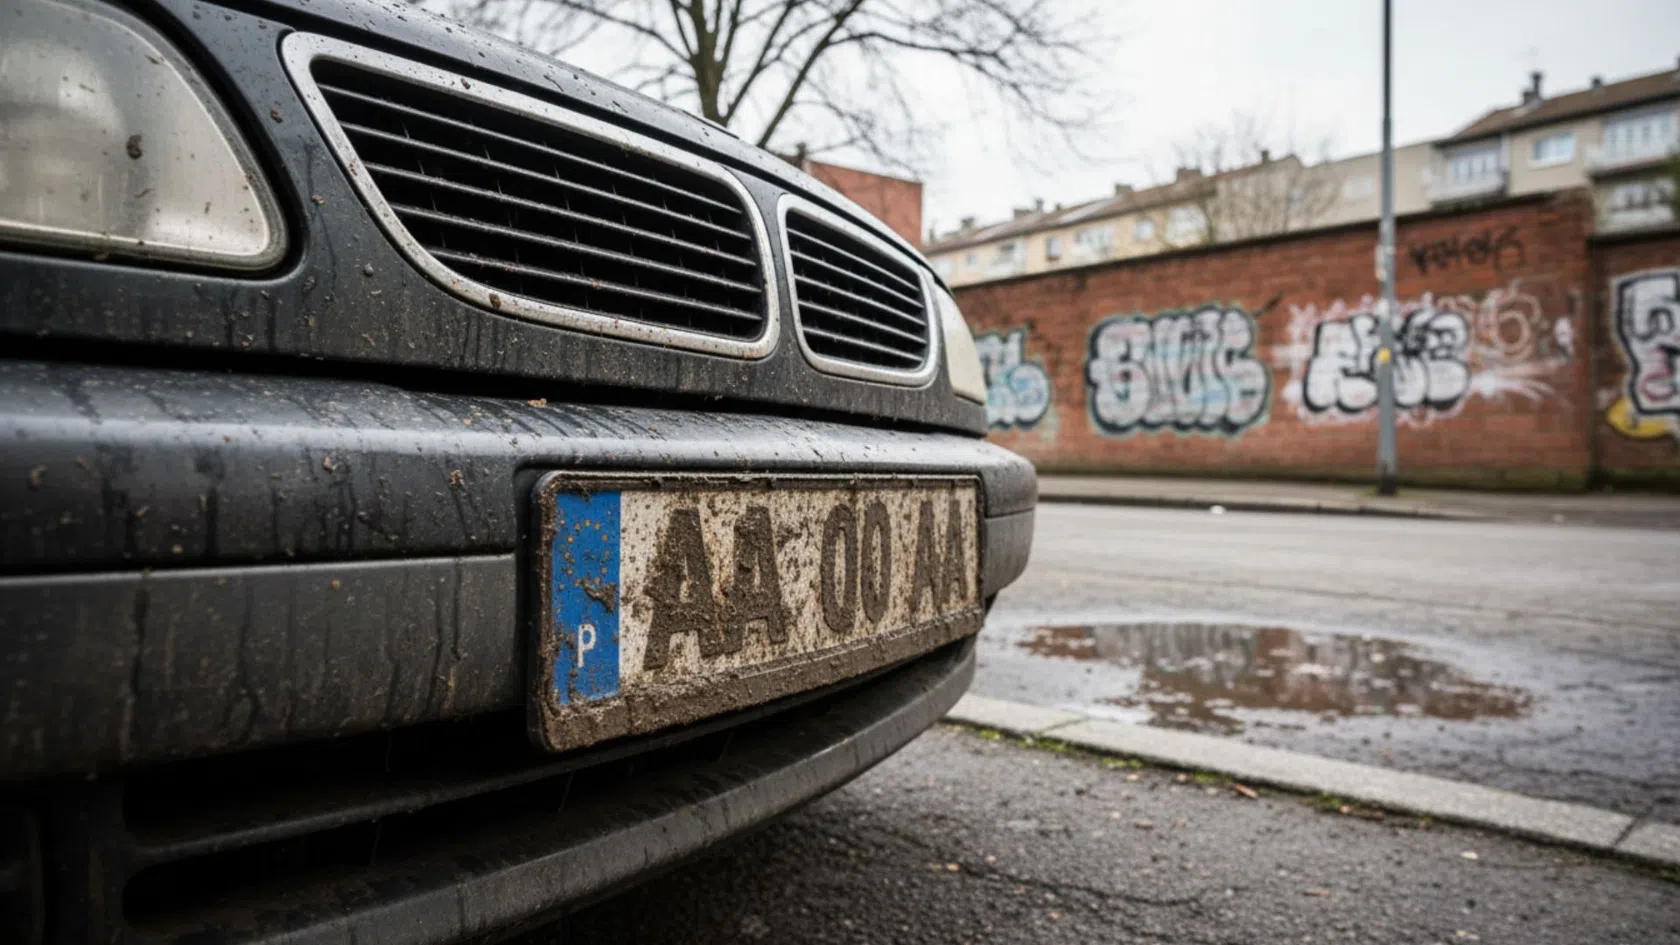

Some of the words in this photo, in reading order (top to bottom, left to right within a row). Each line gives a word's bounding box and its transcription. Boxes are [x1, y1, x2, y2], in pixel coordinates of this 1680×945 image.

[643, 507, 787, 671] AA
[910, 500, 969, 613] AA
[577, 623, 596, 668] P
